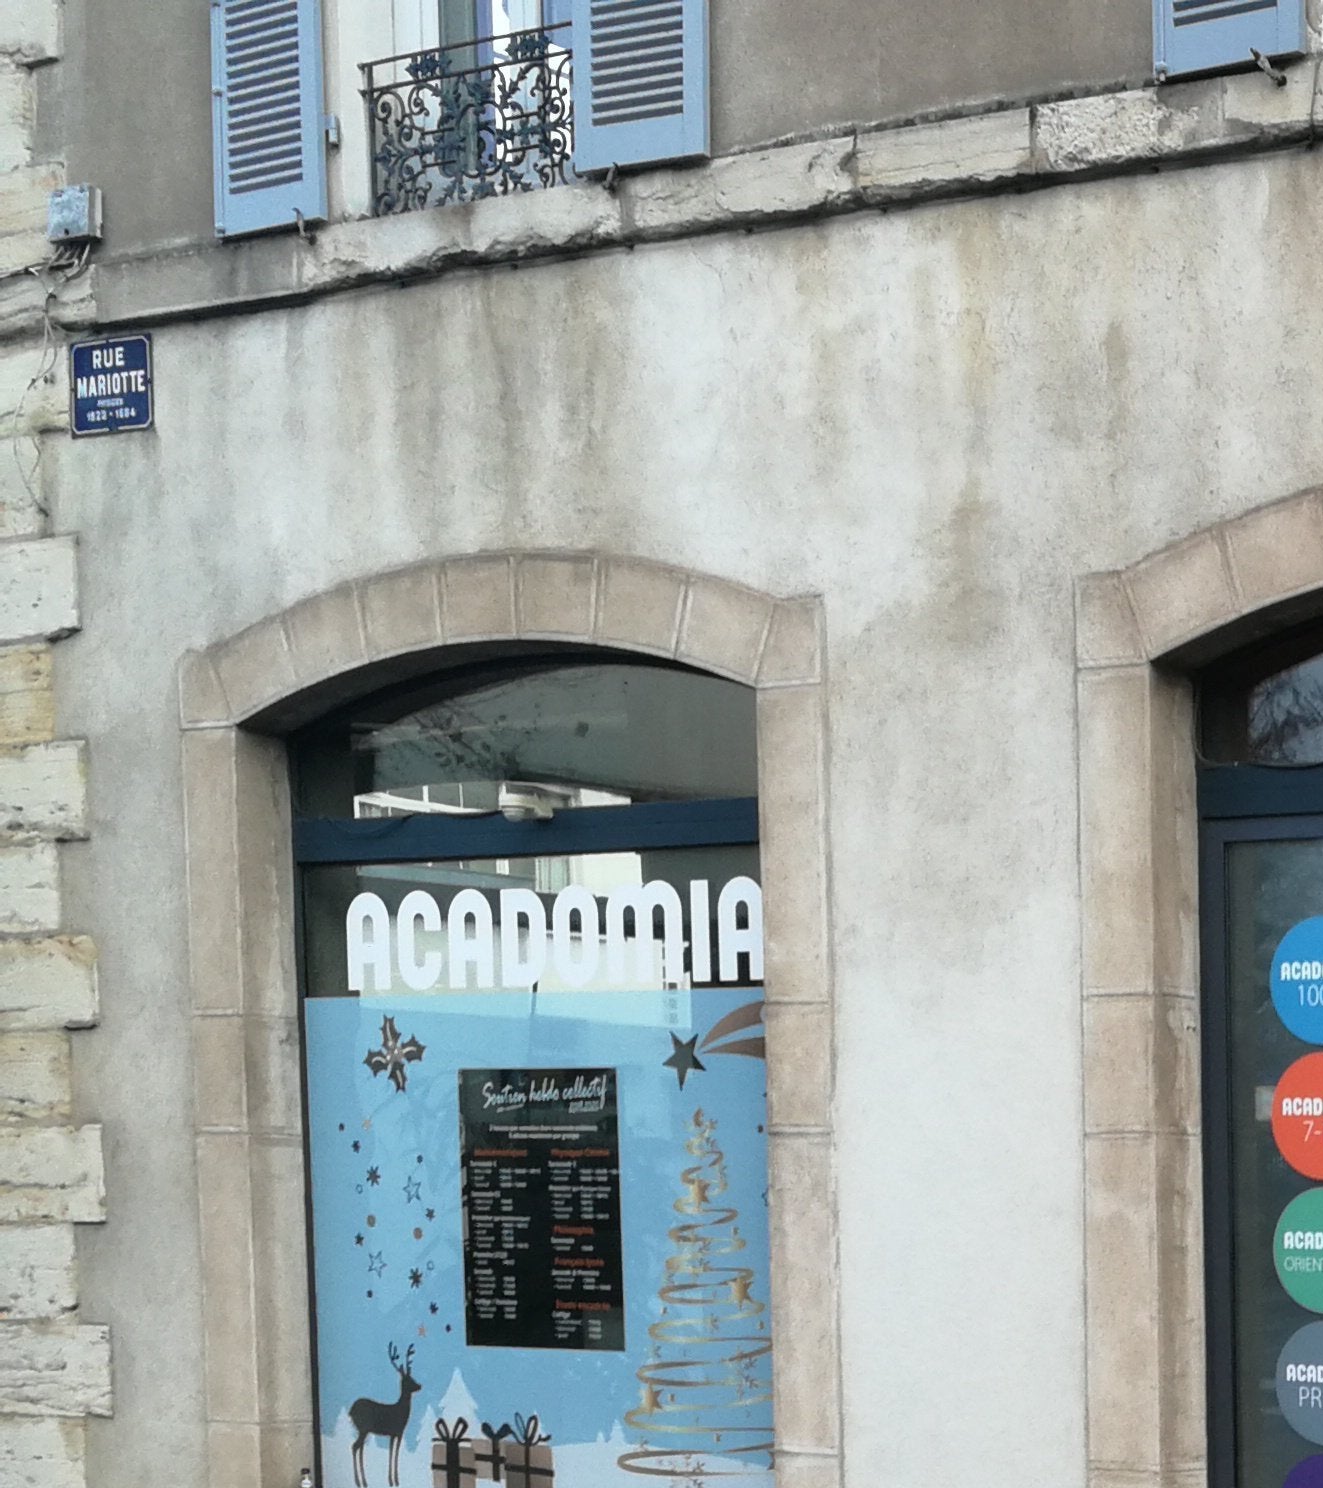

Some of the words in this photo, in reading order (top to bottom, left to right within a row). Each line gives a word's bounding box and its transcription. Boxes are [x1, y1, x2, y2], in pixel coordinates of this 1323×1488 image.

[92, 346, 125, 369] RUE
[77, 370, 146, 399] MARIOTTE
[346, 876, 764, 991] ACADOMIA
